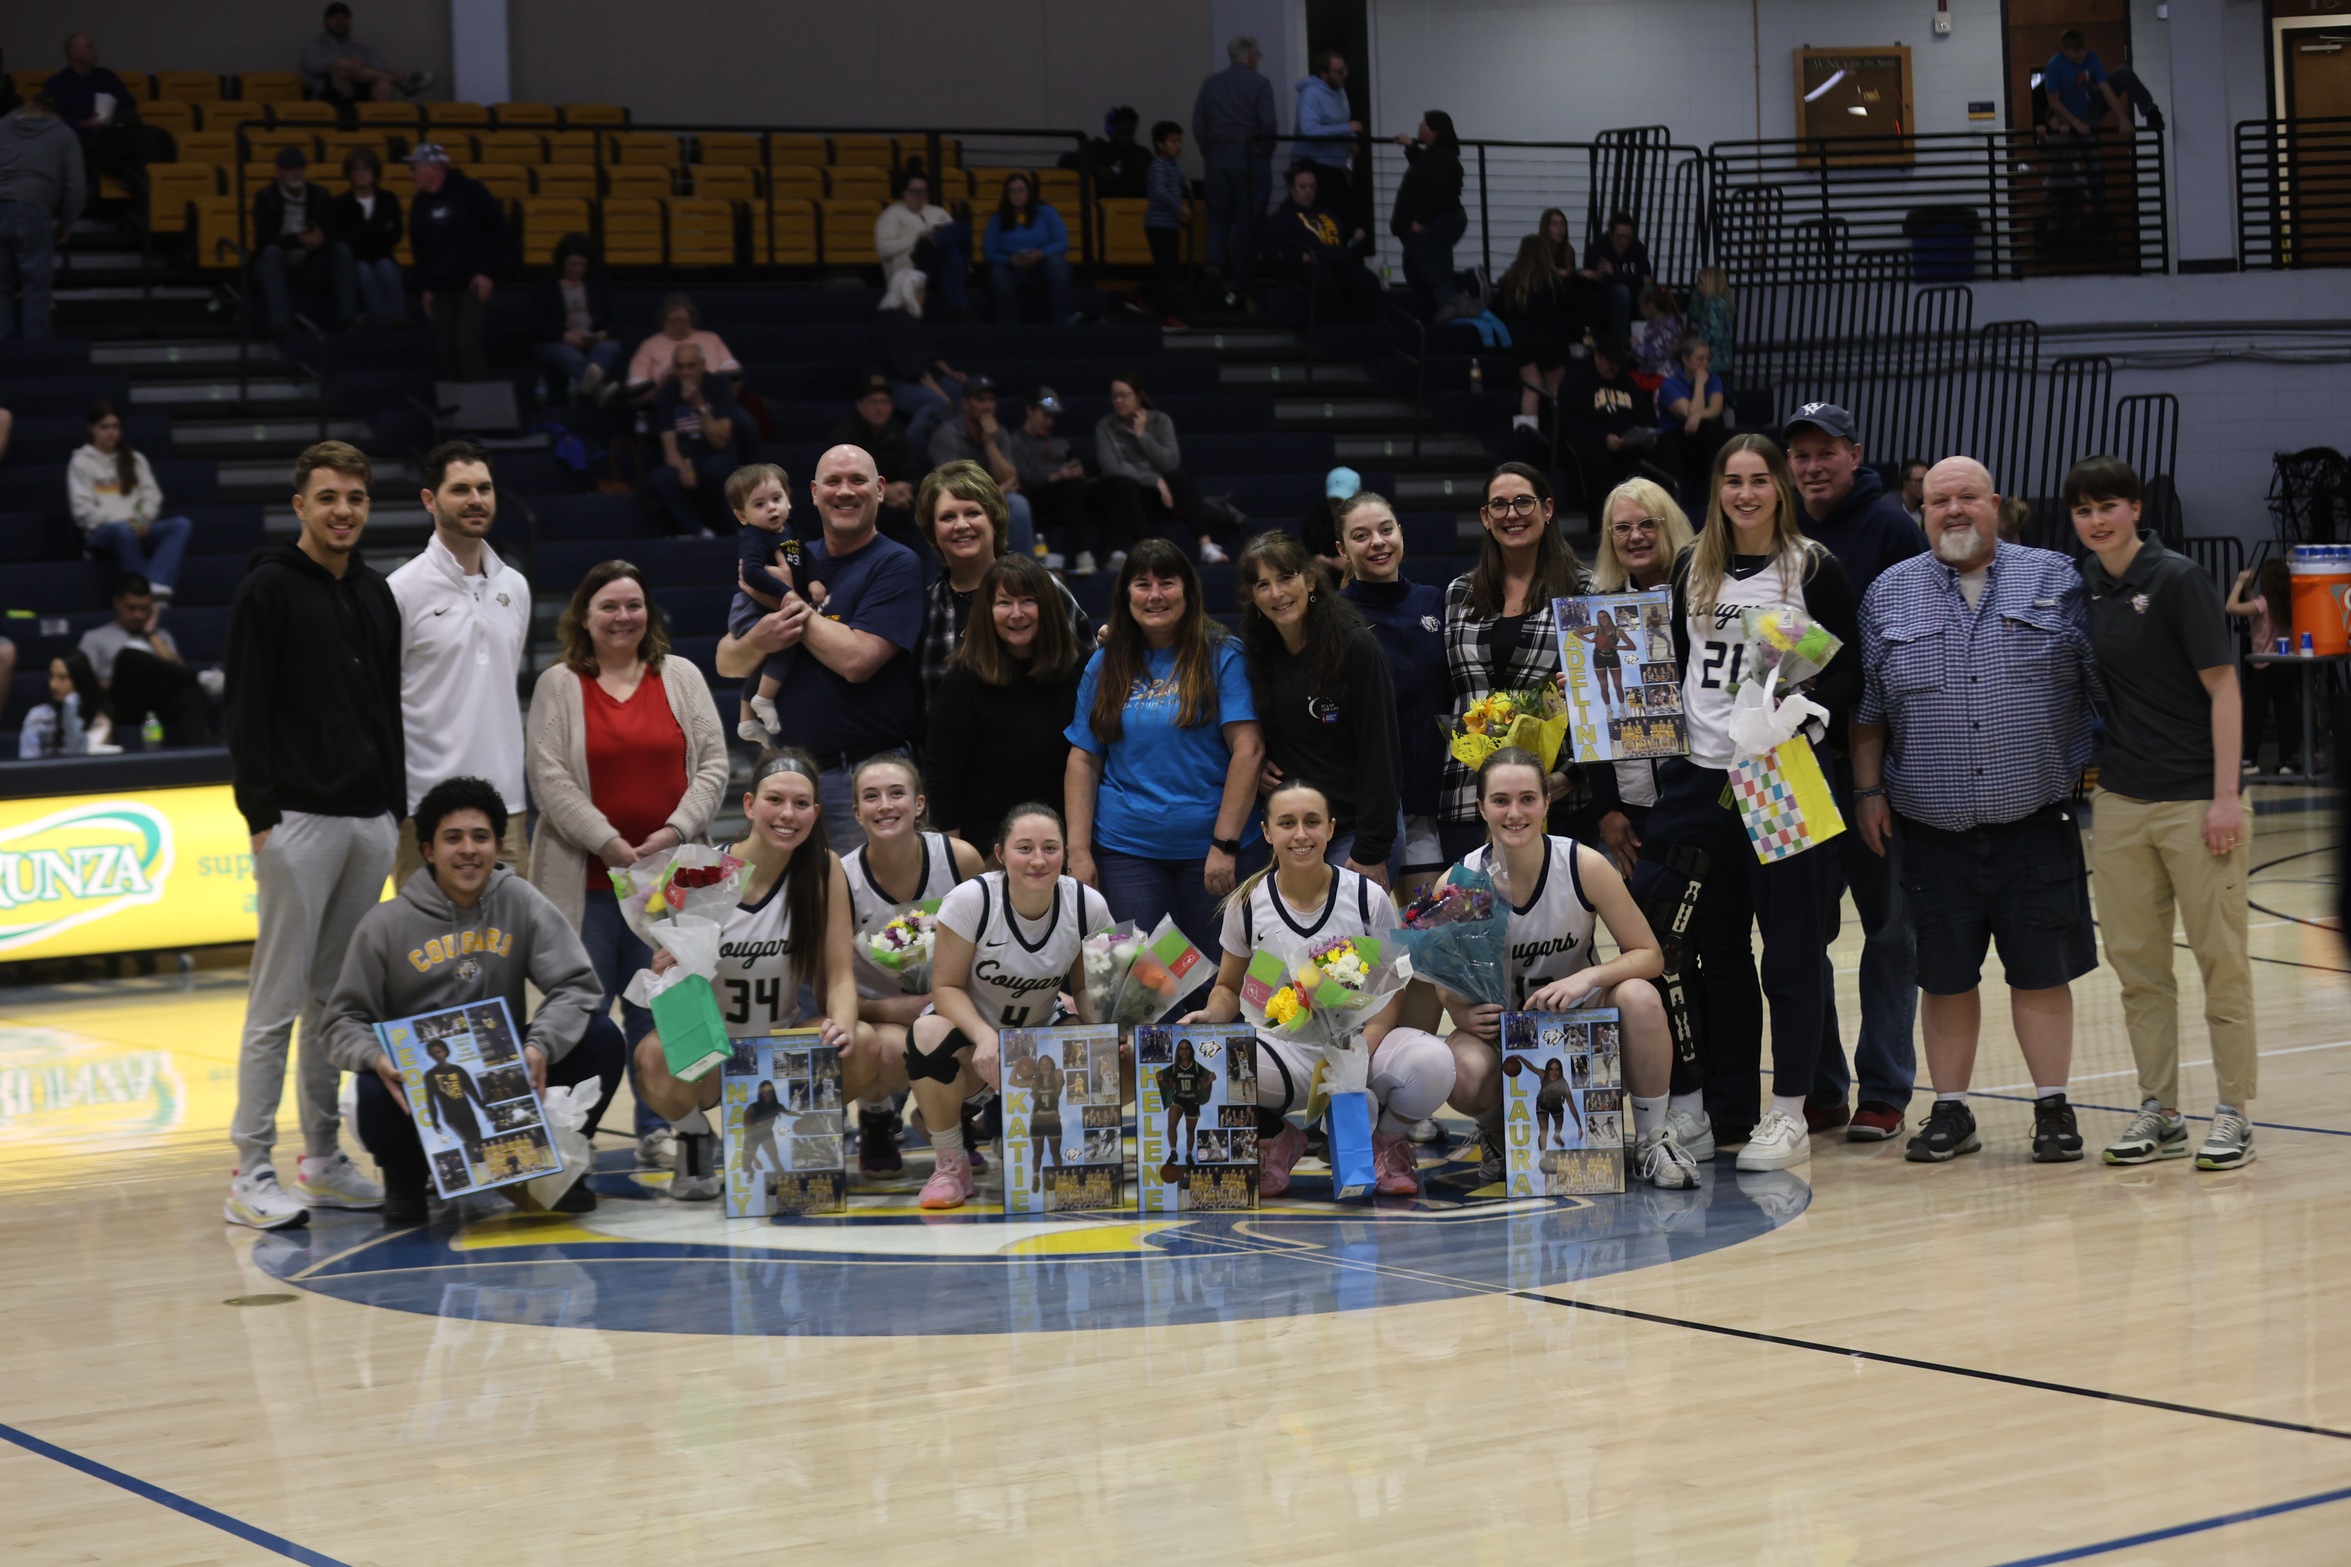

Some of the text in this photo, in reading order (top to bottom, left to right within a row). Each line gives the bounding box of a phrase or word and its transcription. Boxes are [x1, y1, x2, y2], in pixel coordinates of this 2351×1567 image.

[1563, 632, 1600, 761] ADELINA
[1701, 641, 1745, 688] 21
[0, 844, 153, 909] UNZA
[408, 928, 514, 973] COUGARS
[725, 977, 781, 1024] 34
[1001, 1005, 1031, 1028] 4
[389, 1028, 433, 1128] PEDRO
[1180, 1079, 1192, 1092] 10
[725, 1082, 753, 1217] NATALY
[1006, 1092, 1030, 1212] KATIE
[1140, 1065, 1164, 1213] HELENE
[1508, 1076, 1534, 1196] LAURA
